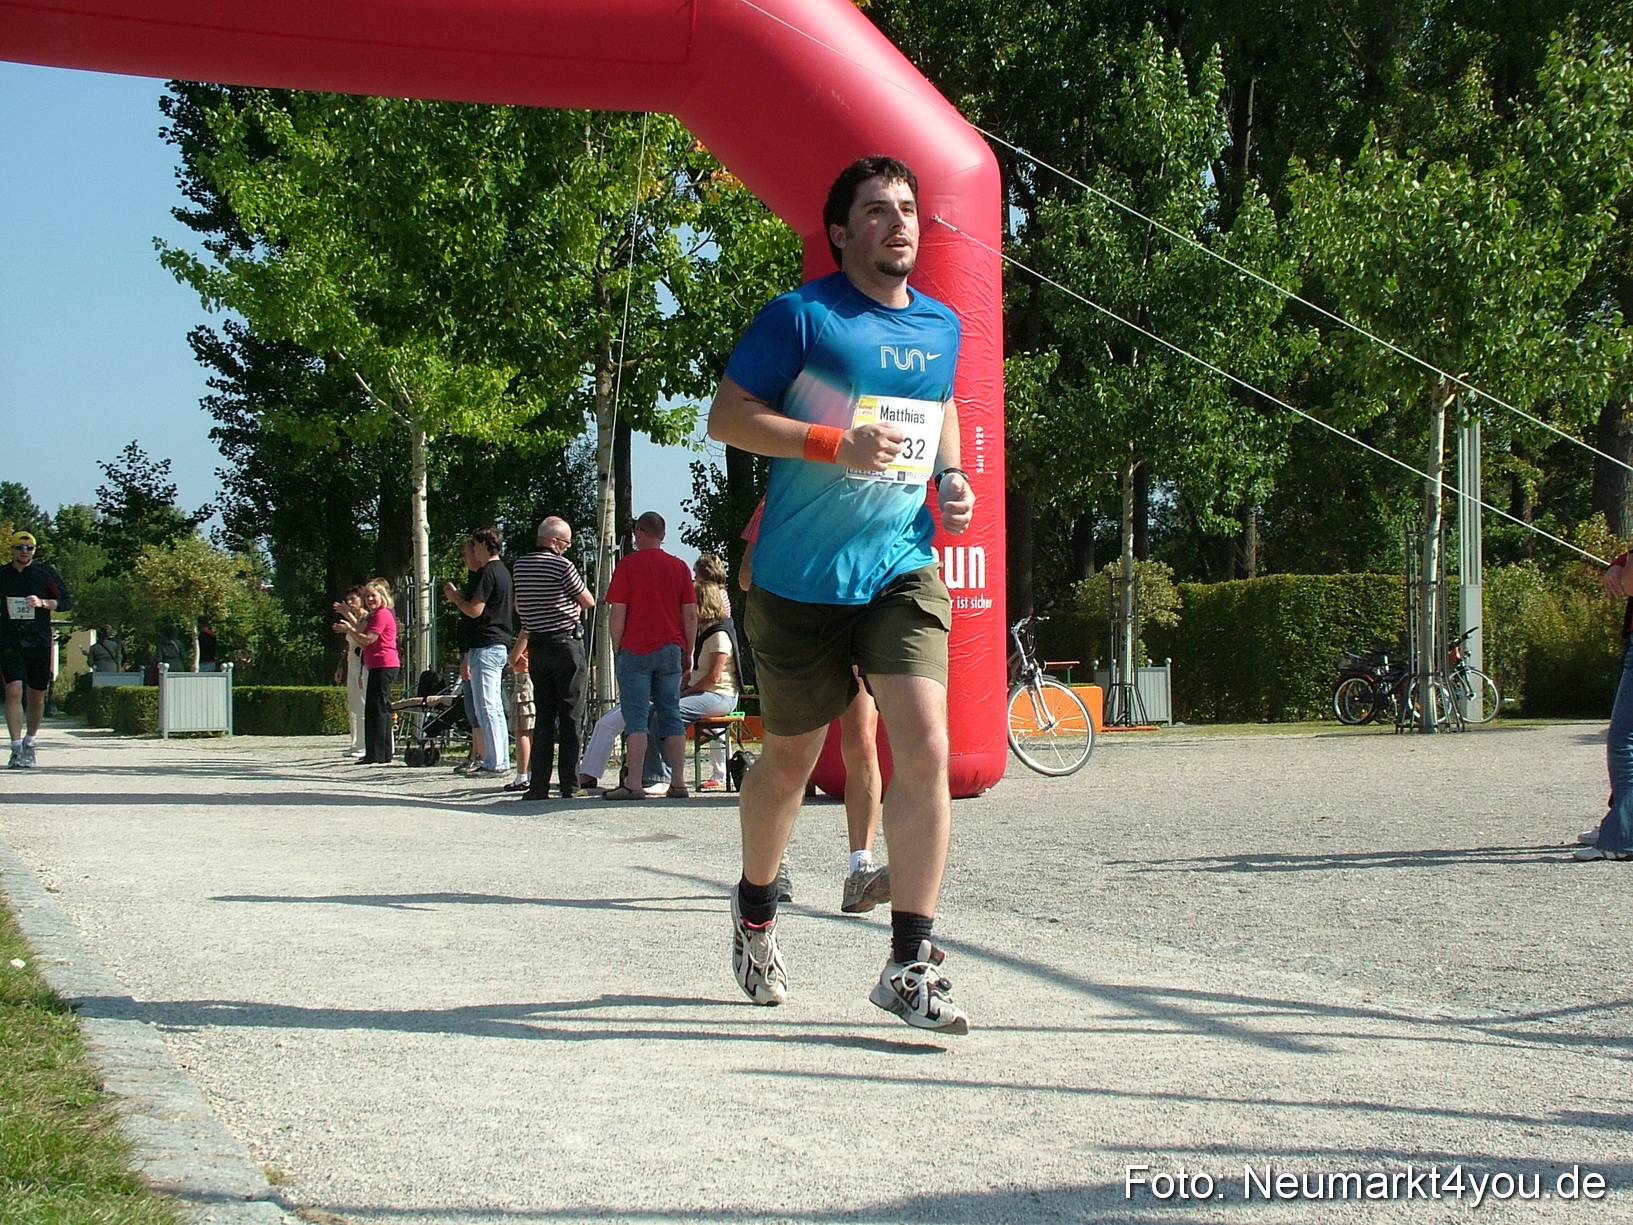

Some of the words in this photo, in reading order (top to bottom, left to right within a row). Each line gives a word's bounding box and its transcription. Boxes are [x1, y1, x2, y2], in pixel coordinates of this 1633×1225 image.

[879, 404, 926, 424] Matthias
[975, 426, 985, 451] 1929
[931, 545, 986, 590] un
[957, 595, 968, 609] ist
[970, 593, 993, 609] sicher
